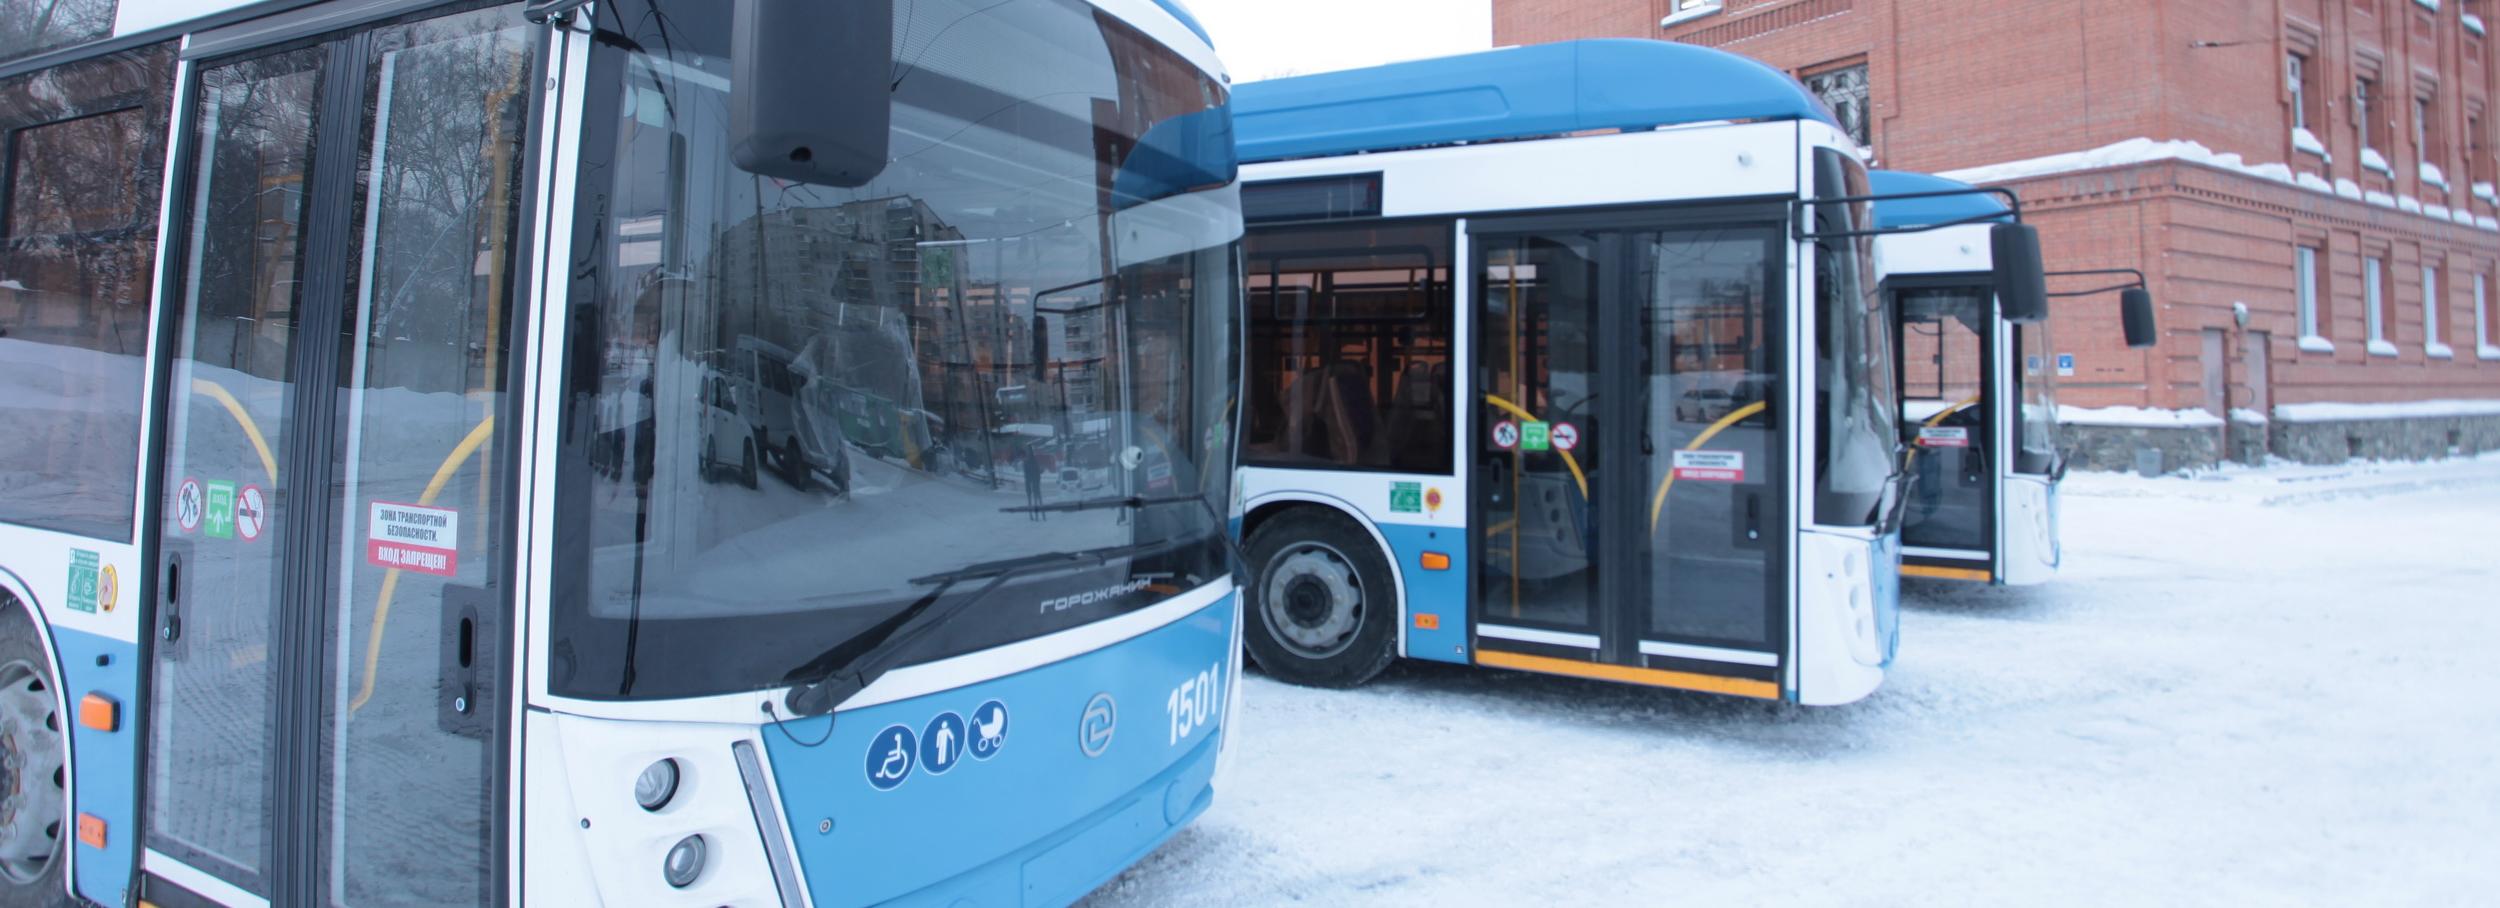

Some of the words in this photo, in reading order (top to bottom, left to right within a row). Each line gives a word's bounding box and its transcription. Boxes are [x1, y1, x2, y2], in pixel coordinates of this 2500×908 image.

[380, 509, 397, 521] ЗОНА
[398, 511, 447, 528] ТРАНСПОРТНОЙ
[378, 546, 400, 565] ВХОД
[400, 549, 447, 570] ЗАПРЕЩЕН!
[1040, 577, 1152, 615] ГОРОЖАНИН
[1167, 662, 1219, 746] 1501
